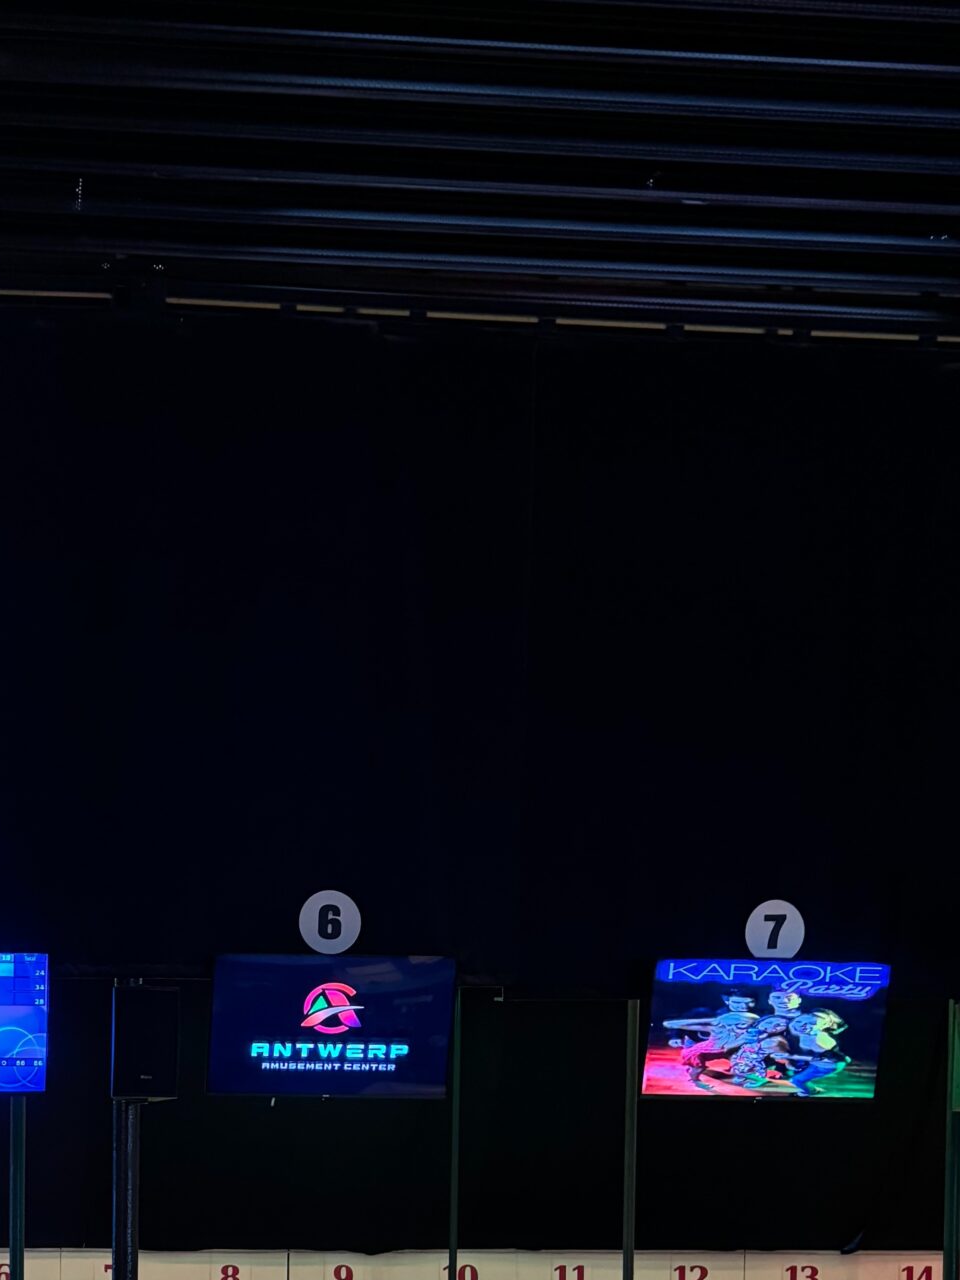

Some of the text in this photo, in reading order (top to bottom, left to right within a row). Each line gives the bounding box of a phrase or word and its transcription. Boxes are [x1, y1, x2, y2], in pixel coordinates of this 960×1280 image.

[317, 903, 342, 940] 6
[763, 913, 787, 950] 7
[667, 962, 883, 984] KARAOKE
[781, 979, 872, 997] Party
[250, 1042, 410, 1059] ANTWERP
[261, 1062, 396, 1072] AMUSEMENT CENTER
